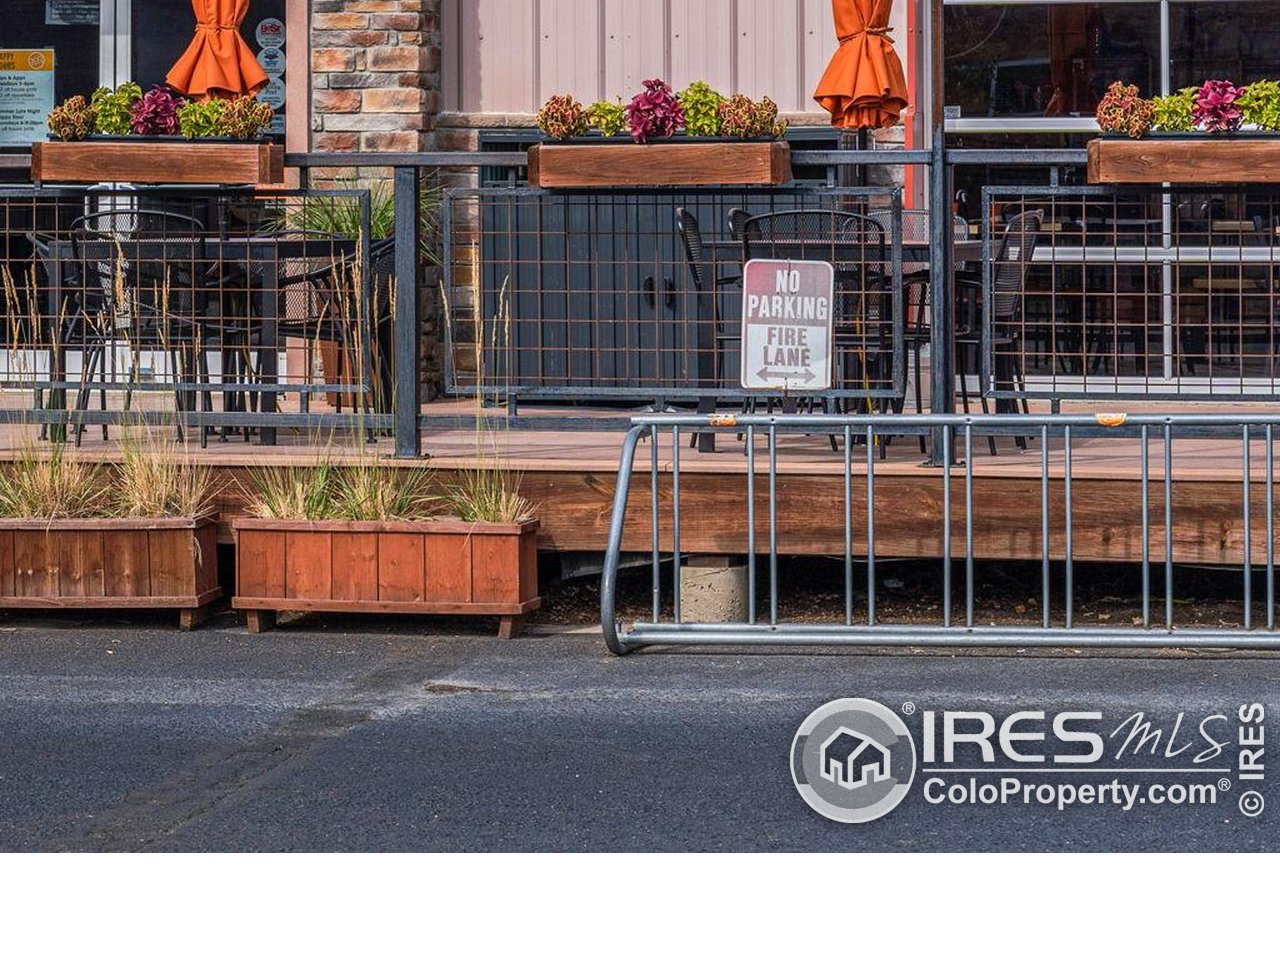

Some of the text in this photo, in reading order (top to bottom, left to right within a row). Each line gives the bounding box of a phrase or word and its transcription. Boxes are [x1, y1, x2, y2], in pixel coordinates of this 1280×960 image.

[775, 269, 801, 293] NO
[747, 294, 828, 320] PARKING
[767, 326, 808, 347] FIRE
[762, 345, 812, 368] LANE
